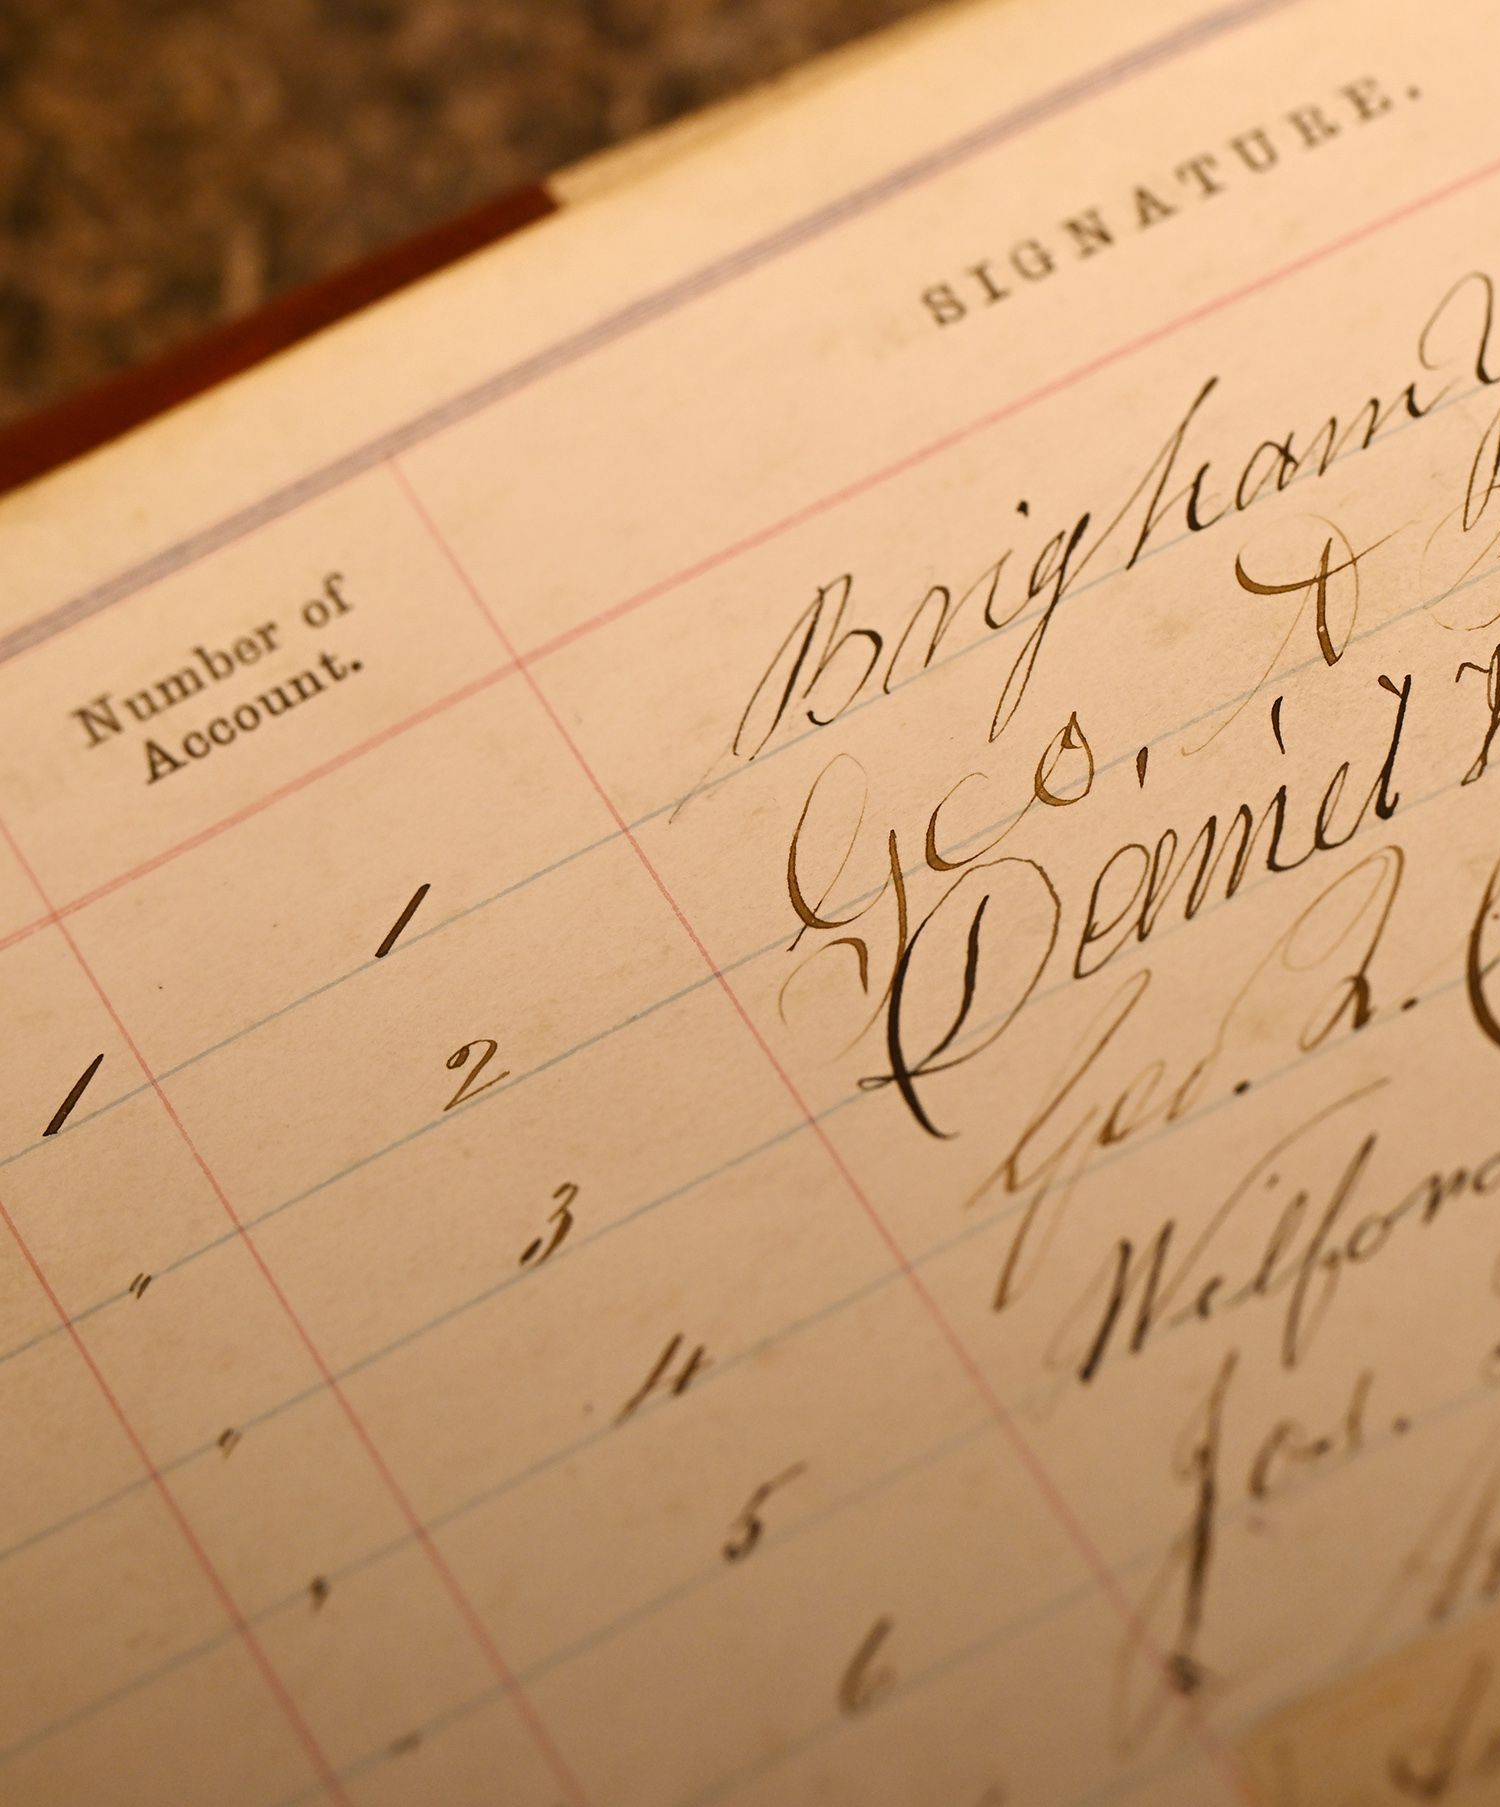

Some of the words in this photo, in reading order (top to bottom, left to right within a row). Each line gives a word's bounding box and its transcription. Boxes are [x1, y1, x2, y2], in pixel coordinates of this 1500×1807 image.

[920, 74, 1425, 328] SIGNATURE.
[670, 374, 1464, 825] Brigham
[70, 614, 283, 750] Number
[301, 570, 356, 630] of
[145, 656, 364, 787] Account.
[374, 883, 432, 959] 1
[858, 672, 1411, 1141] Daniel
[42, 1053, 105, 1138] 1
[442, 1037, 512, 1114] 2
[519, 1181, 580, 1267] 3
[722, 1460, 808, 1566] 5
[836, 1612, 898, 1718] 6
